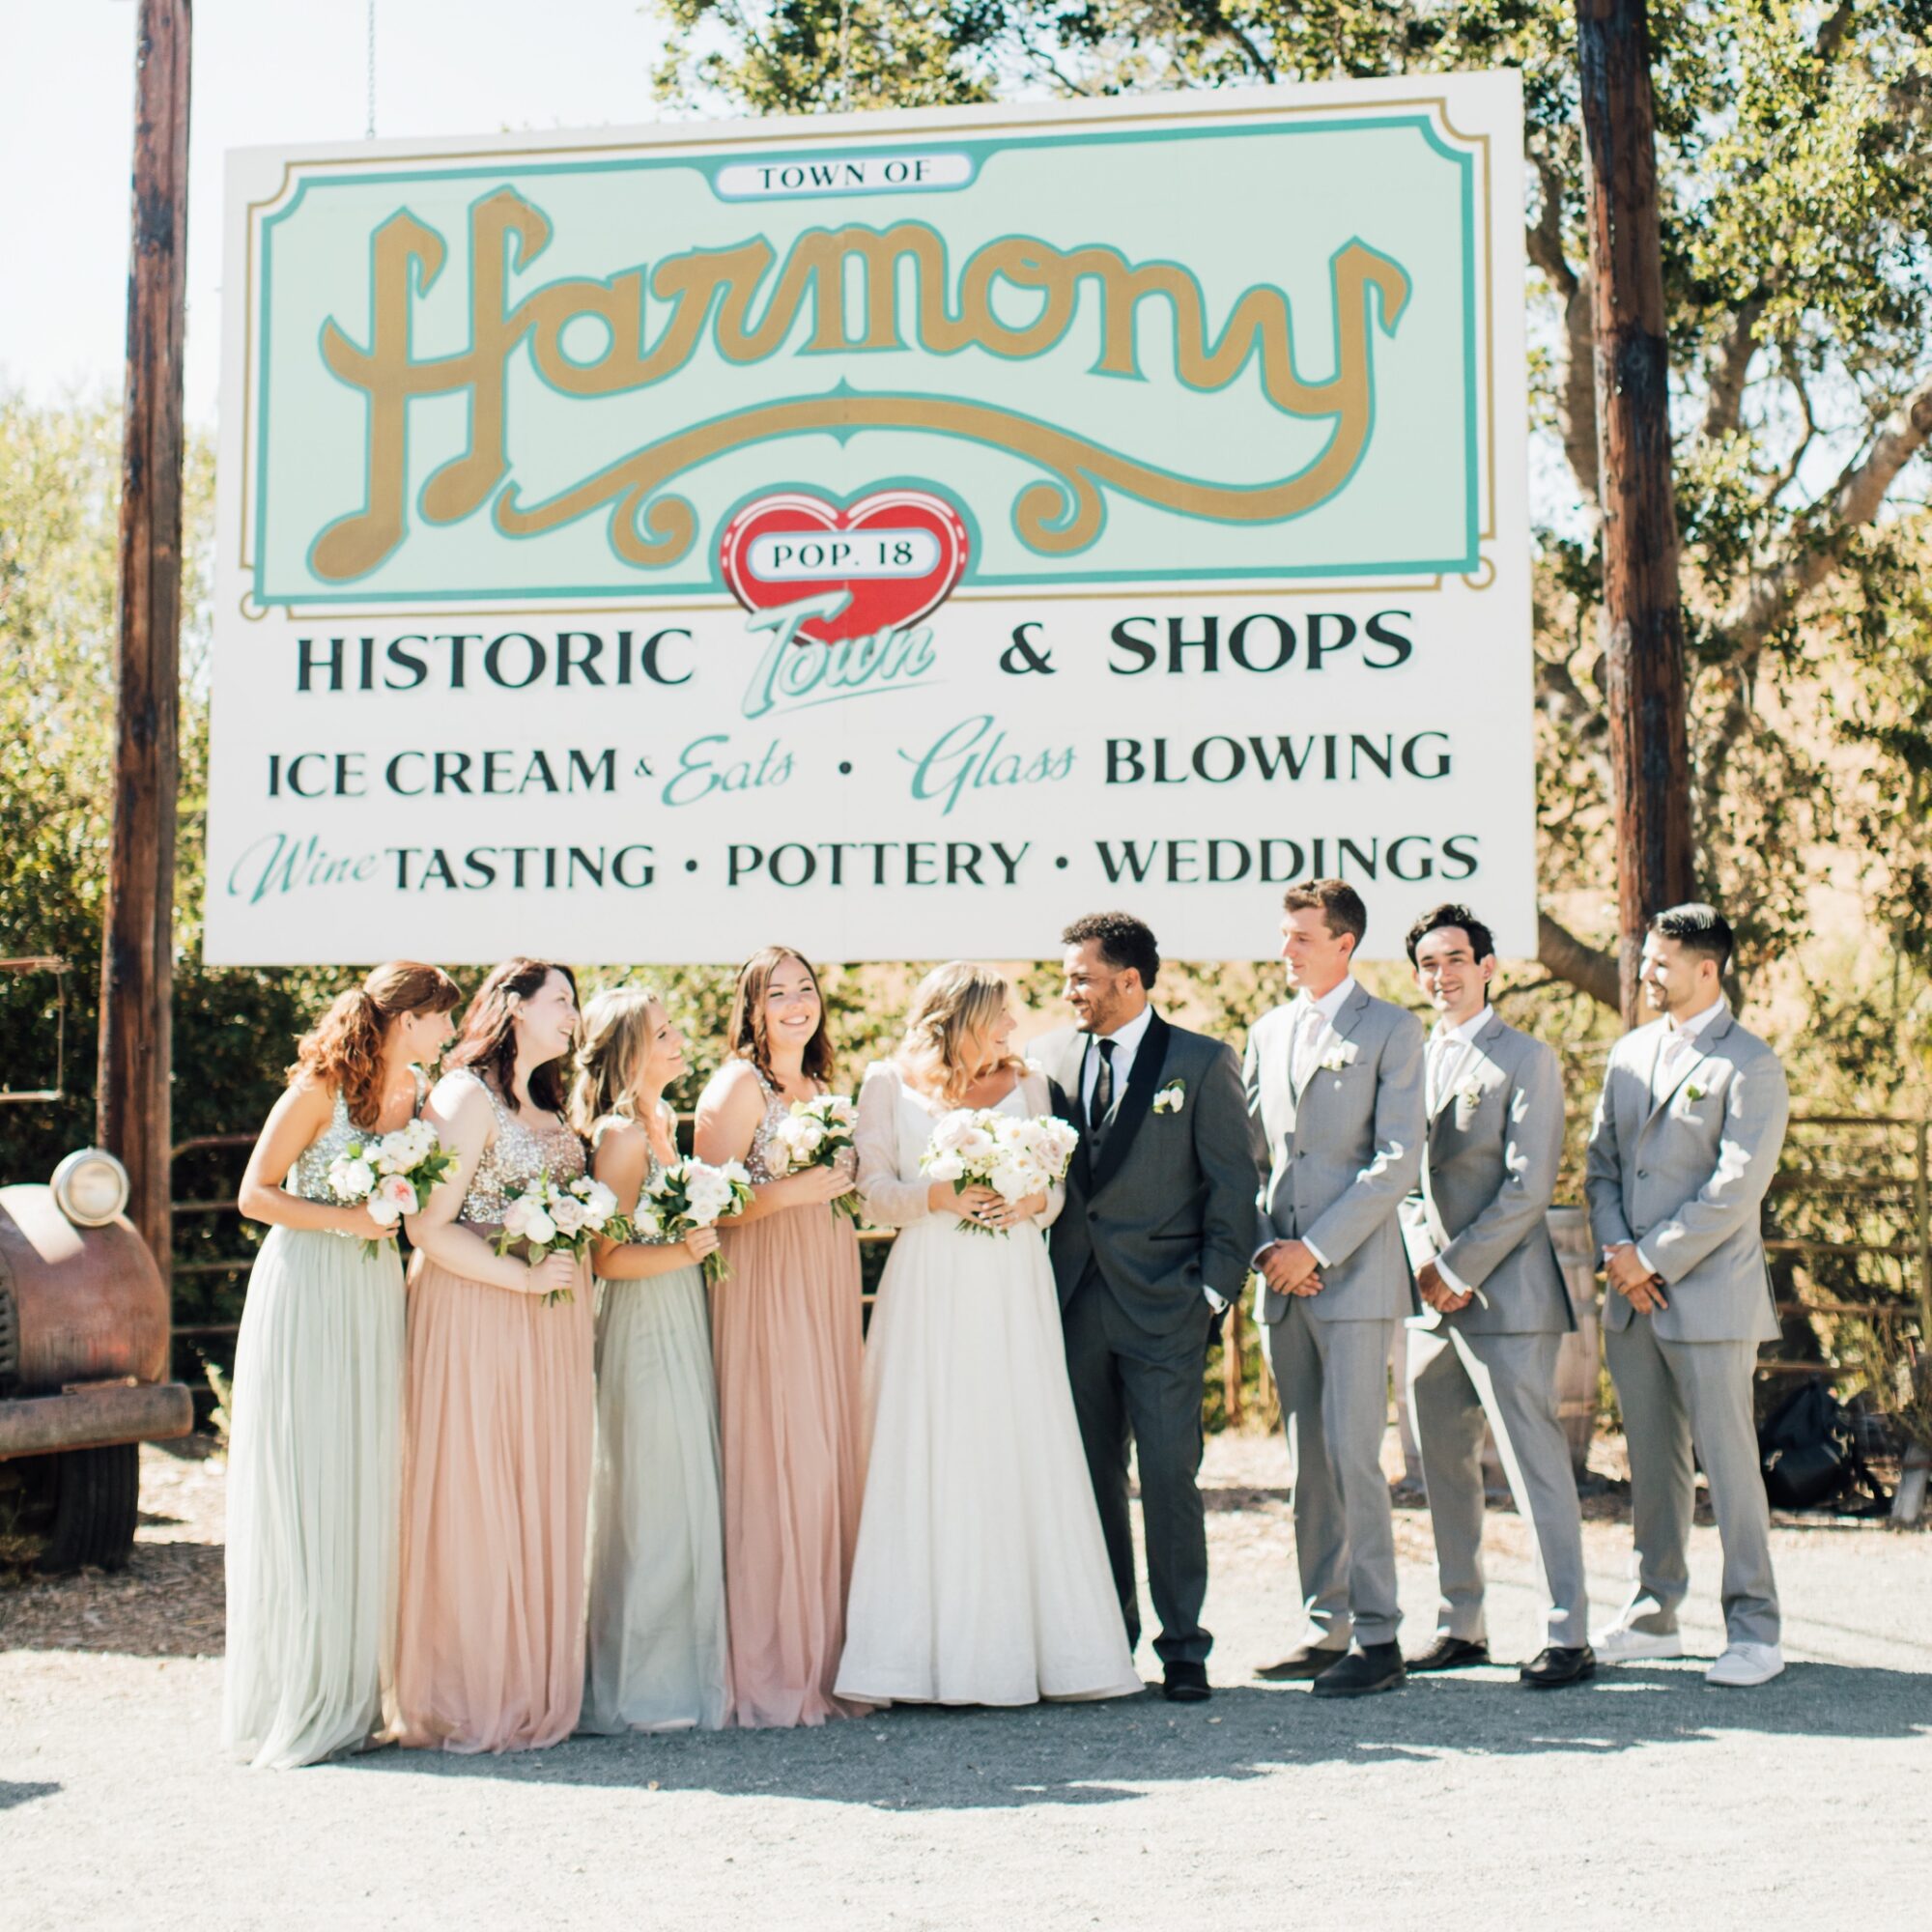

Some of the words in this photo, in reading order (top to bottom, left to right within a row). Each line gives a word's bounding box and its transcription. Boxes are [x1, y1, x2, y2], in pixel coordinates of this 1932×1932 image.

[757, 160, 867, 193] TOWN
[884, 158, 932, 185] OF
[306, 183, 1412, 585] Harmony
[773, 542, 861, 568] POP.
[879, 541, 913, 565] 18
[297, 628, 694, 692] HISTORIC
[742, 589, 936, 719] Town
[1000, 621, 1057, 674] &
[1108, 610, 1412, 674] SHOPS
[269, 753, 367, 797] ICE
[385, 748, 617, 795] CREAM
[635, 755, 654, 776] &
[662, 734, 797, 807] Eats
[897, 714, 1077, 816] Glass
[1104, 731, 1452, 783] BLOWING
[227, 832, 378, 904] Wine
[384, 844, 655, 889] TASTING
[727, 842, 1032, 886] POTTERY
[1094, 835, 1481, 884] WEDDINGS
